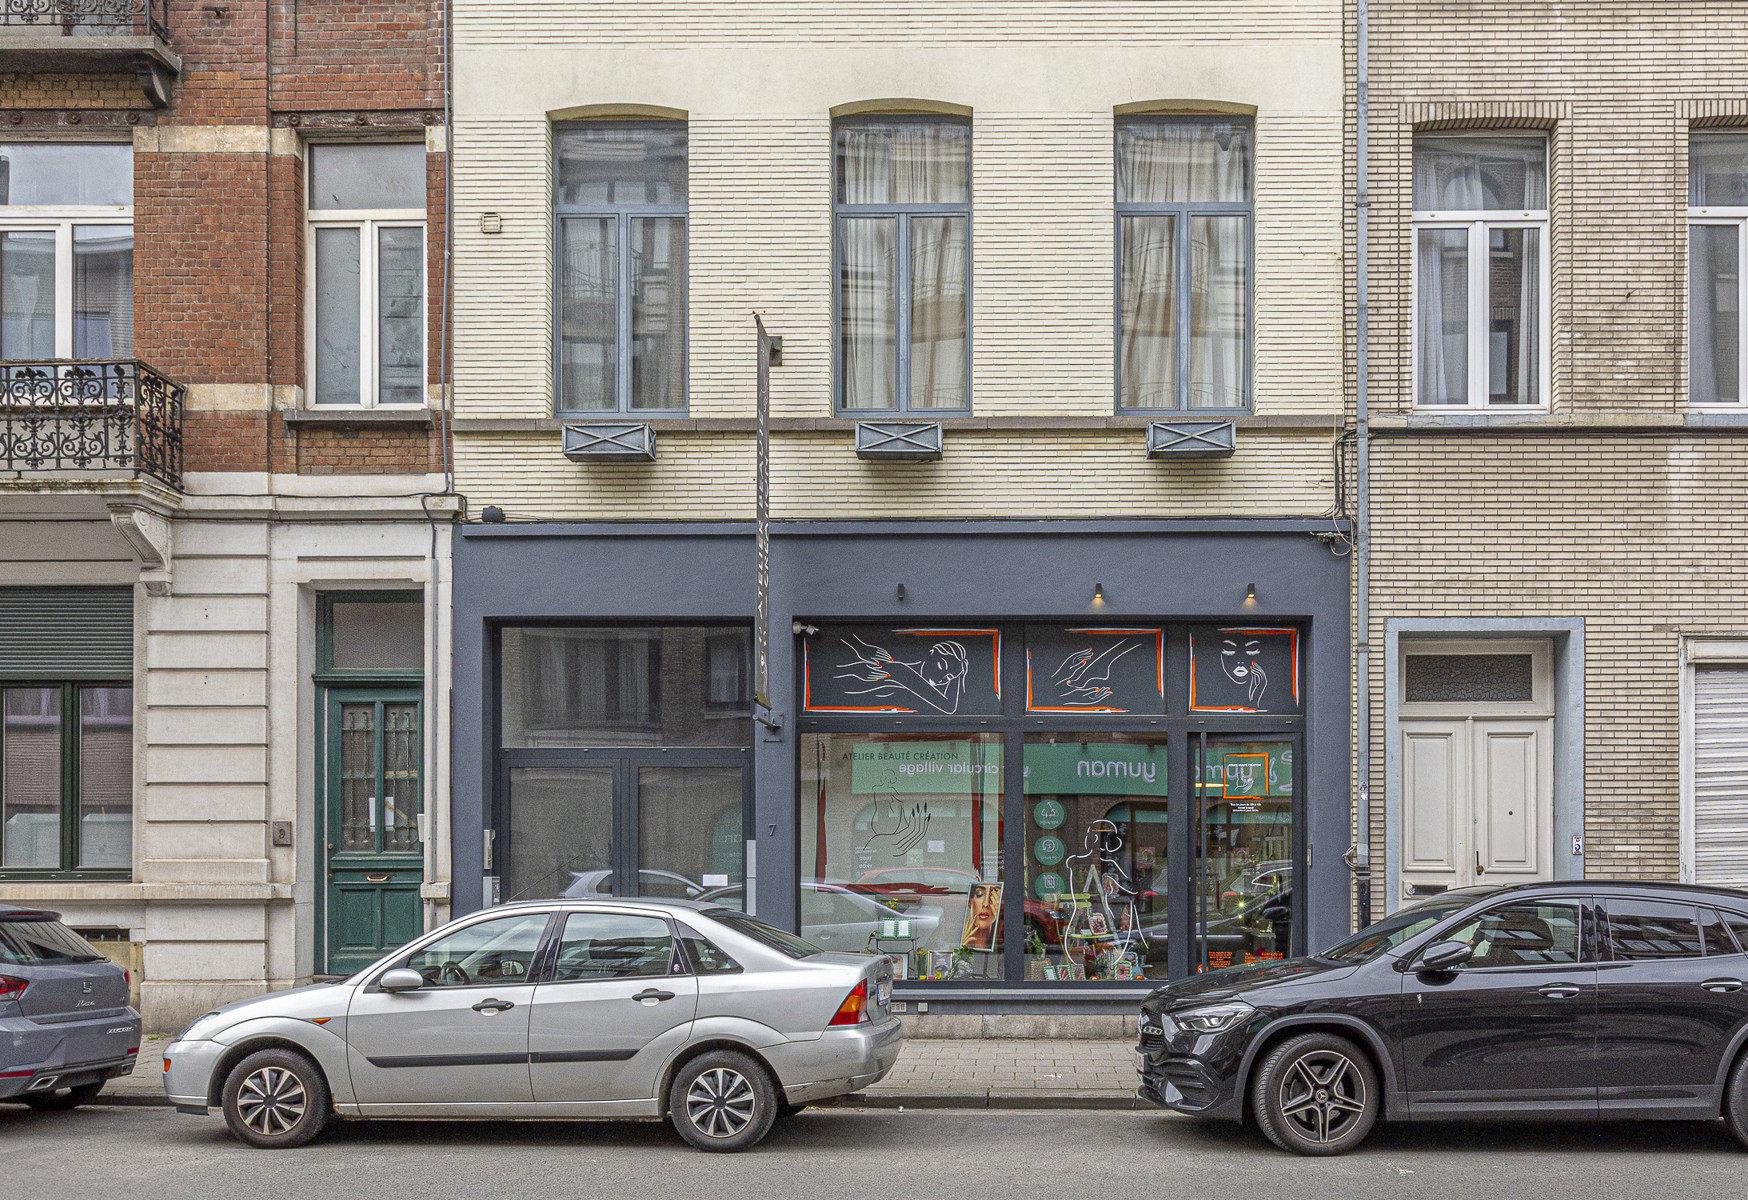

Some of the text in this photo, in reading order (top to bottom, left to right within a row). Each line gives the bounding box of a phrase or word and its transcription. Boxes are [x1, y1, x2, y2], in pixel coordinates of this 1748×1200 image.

[842, 750, 959, 761] ATELIER BEAUTÉ CRÉATION
[768, 823, 777, 837] 7
[1574, 839, 1581, 851] 5
